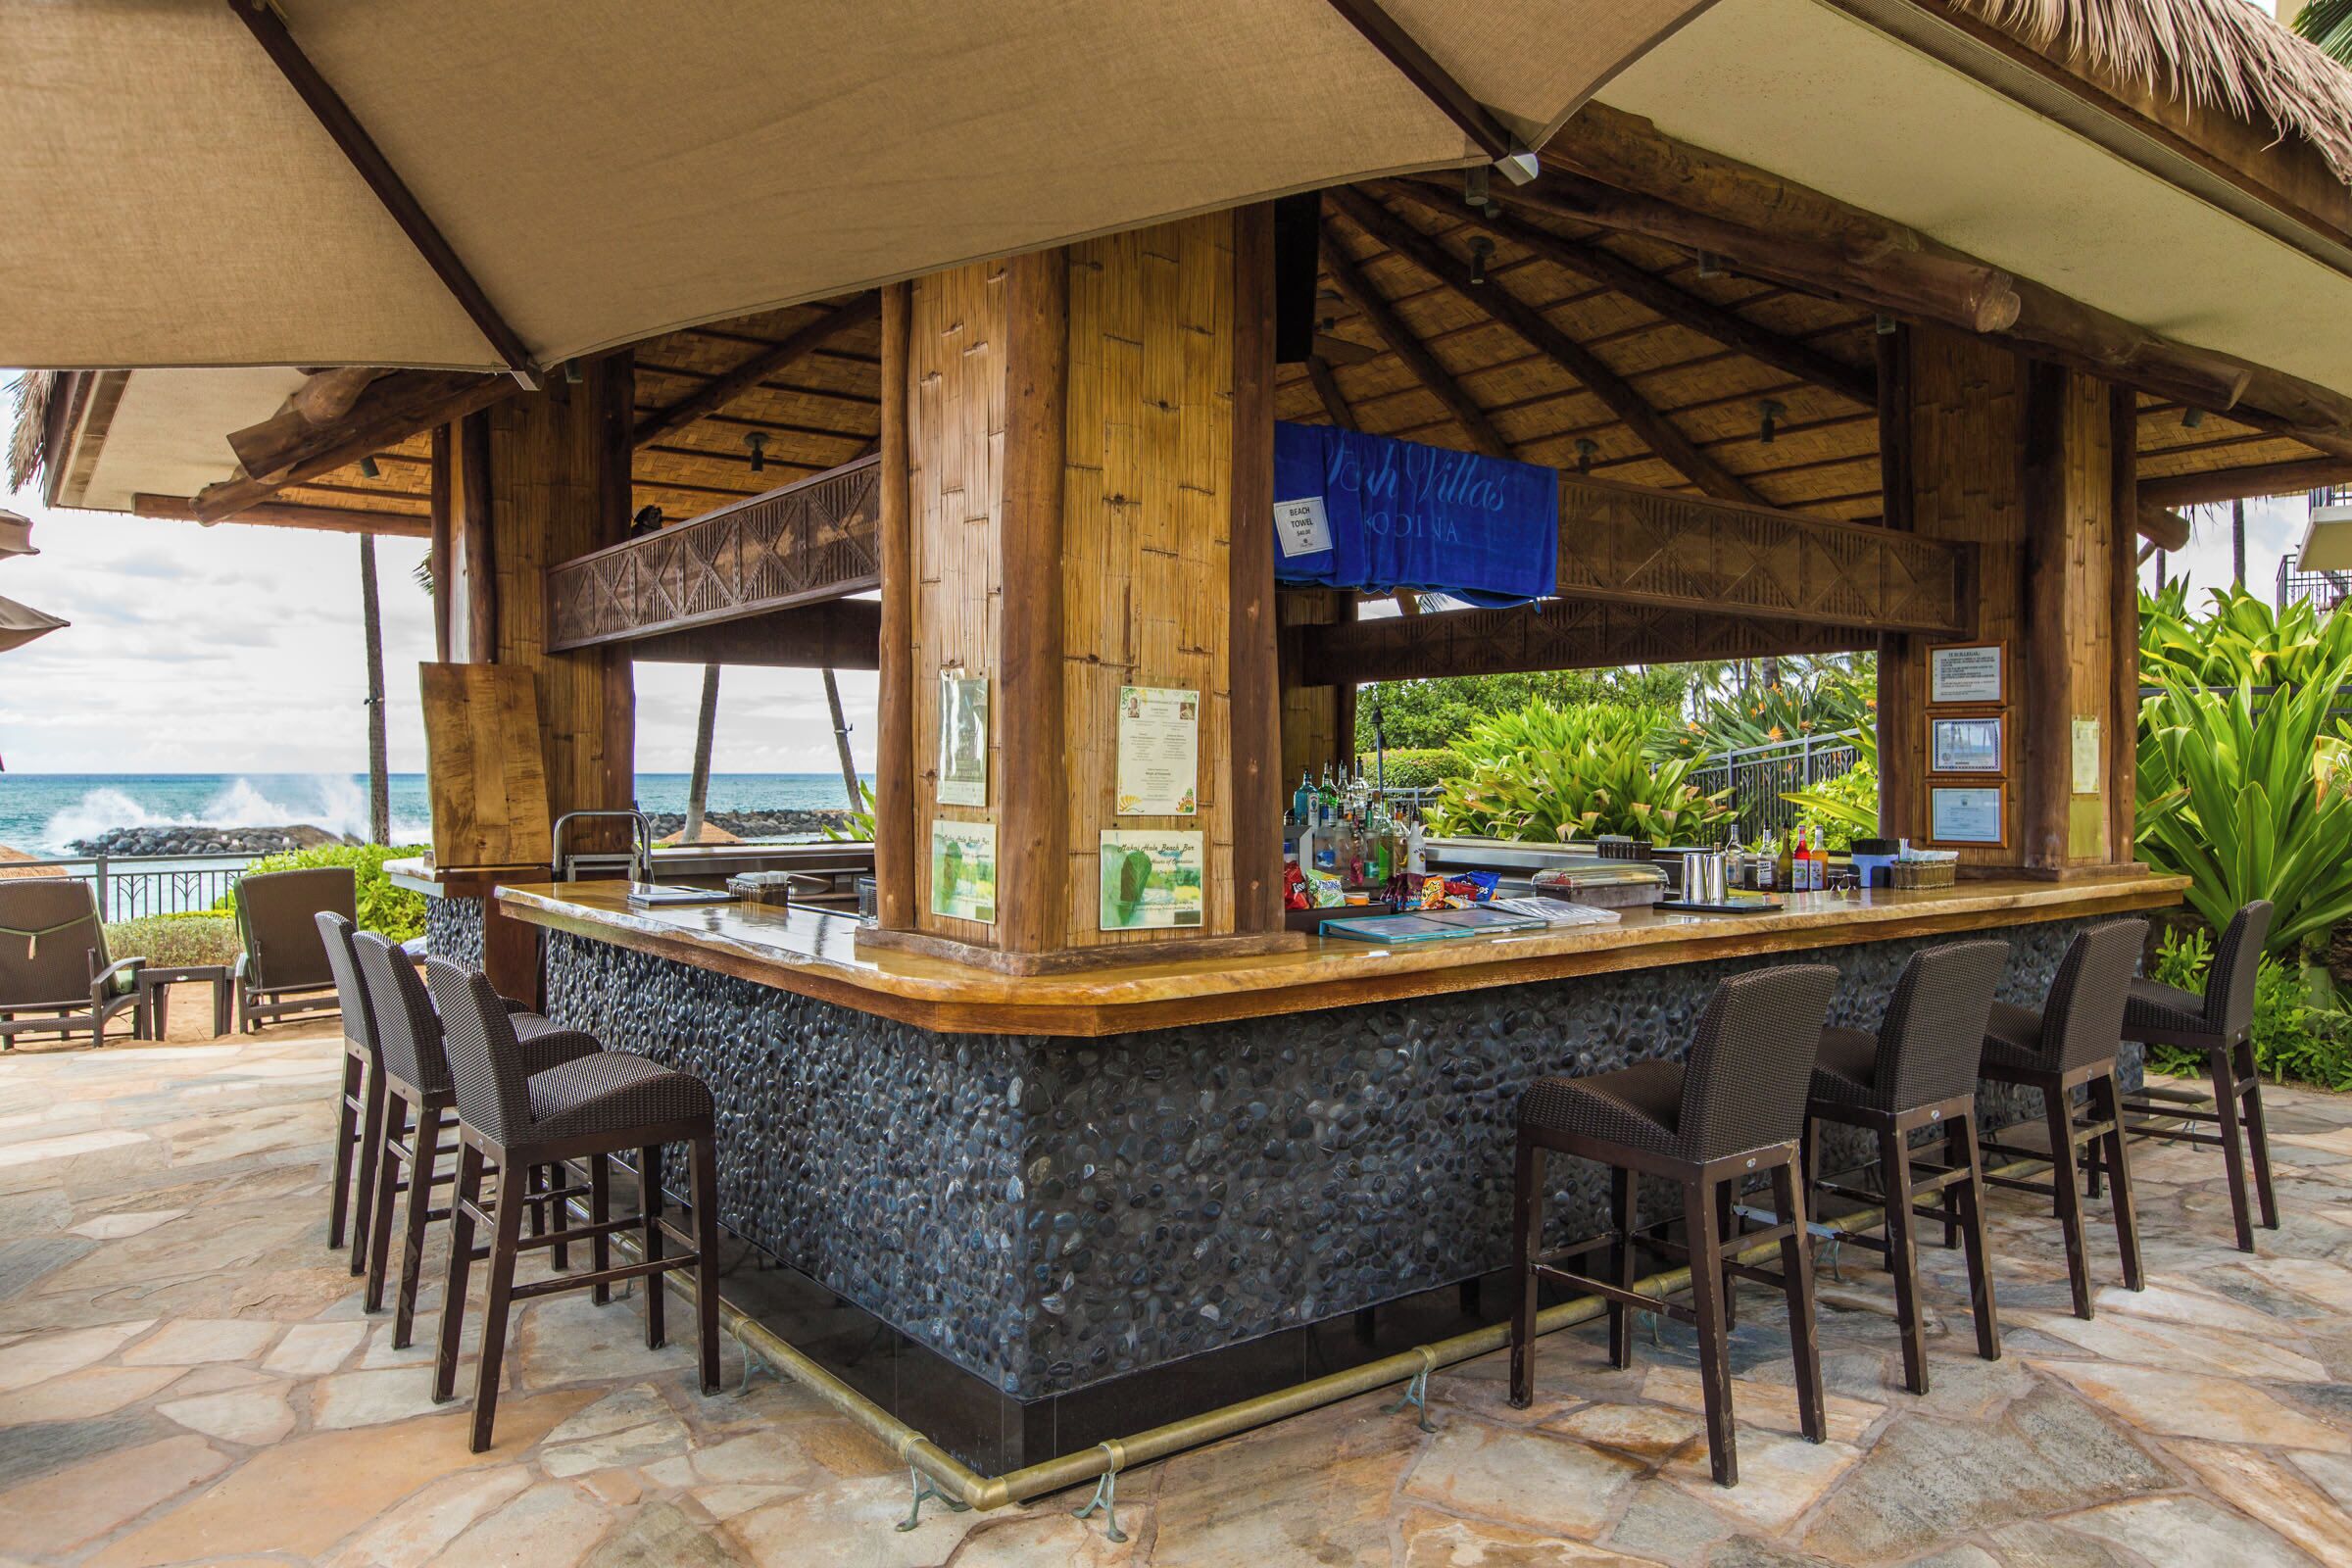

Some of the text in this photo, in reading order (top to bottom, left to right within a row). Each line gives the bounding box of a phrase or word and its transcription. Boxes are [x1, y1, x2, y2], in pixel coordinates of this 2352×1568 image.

[1406, 442, 1506, 512] Villas
[1289, 507, 1310, 516] BEACH
[1291, 518, 1313, 528] TOWEL
[1141, 844, 1158, 854] Hale
[1158, 844, 1180, 855] Beach
[1179, 844, 1195, 854] Bar
